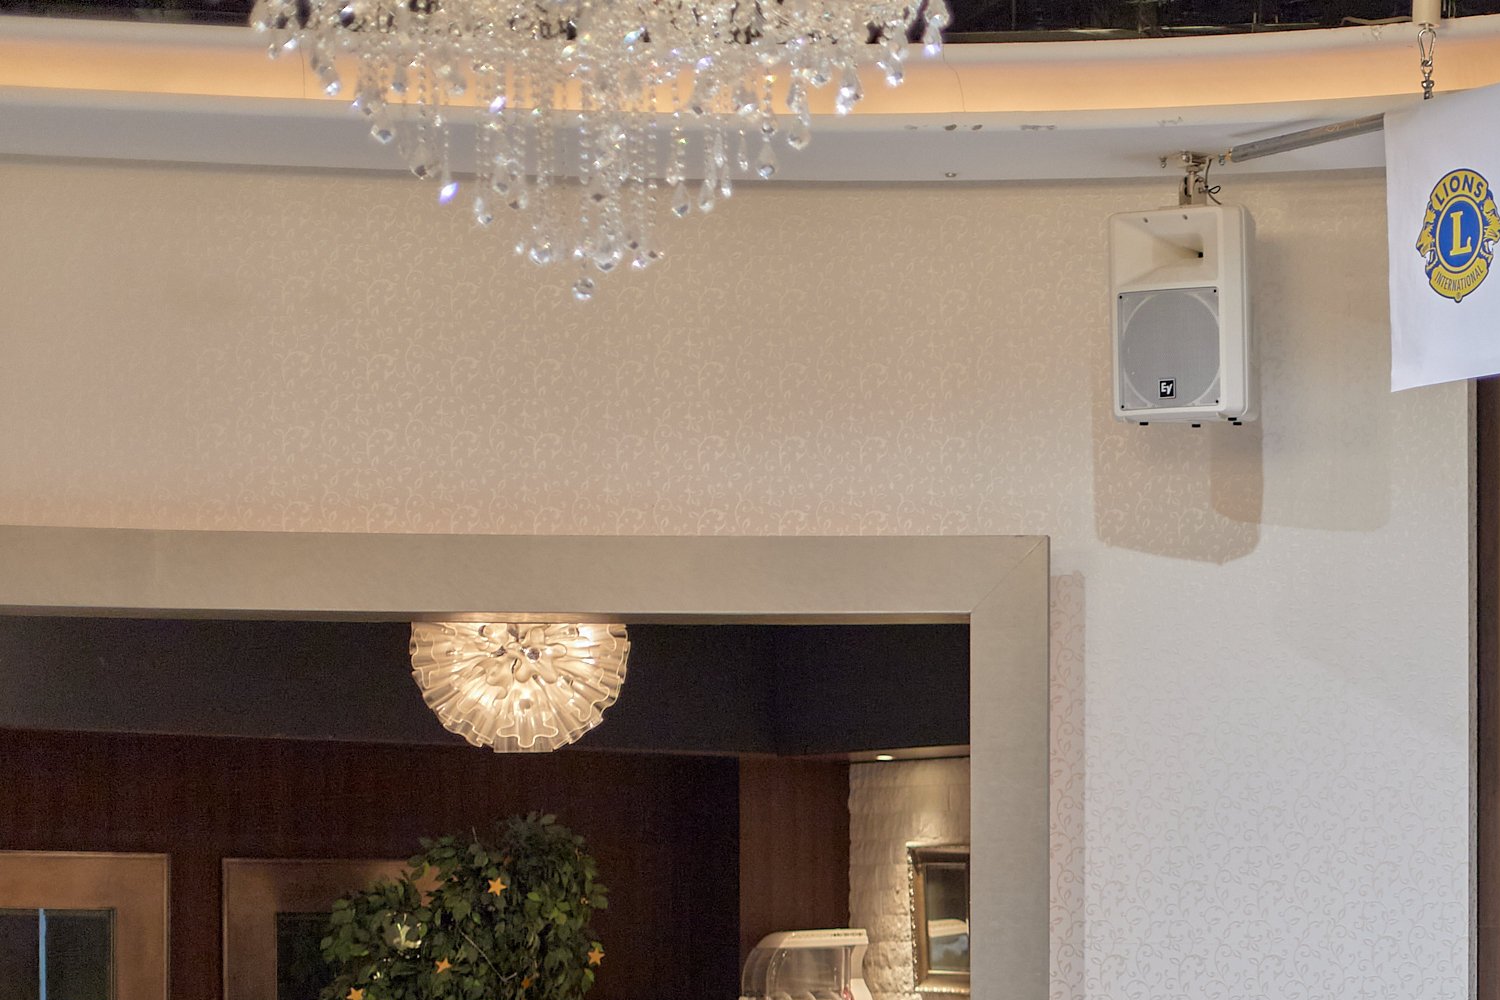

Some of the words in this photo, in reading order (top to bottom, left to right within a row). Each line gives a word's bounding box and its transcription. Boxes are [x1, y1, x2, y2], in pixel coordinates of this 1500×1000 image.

[1435, 174, 1484, 206] LIONS
[1450, 211, 1472, 256] L
[1434, 265, 1484, 292] INTERNATIONAL
